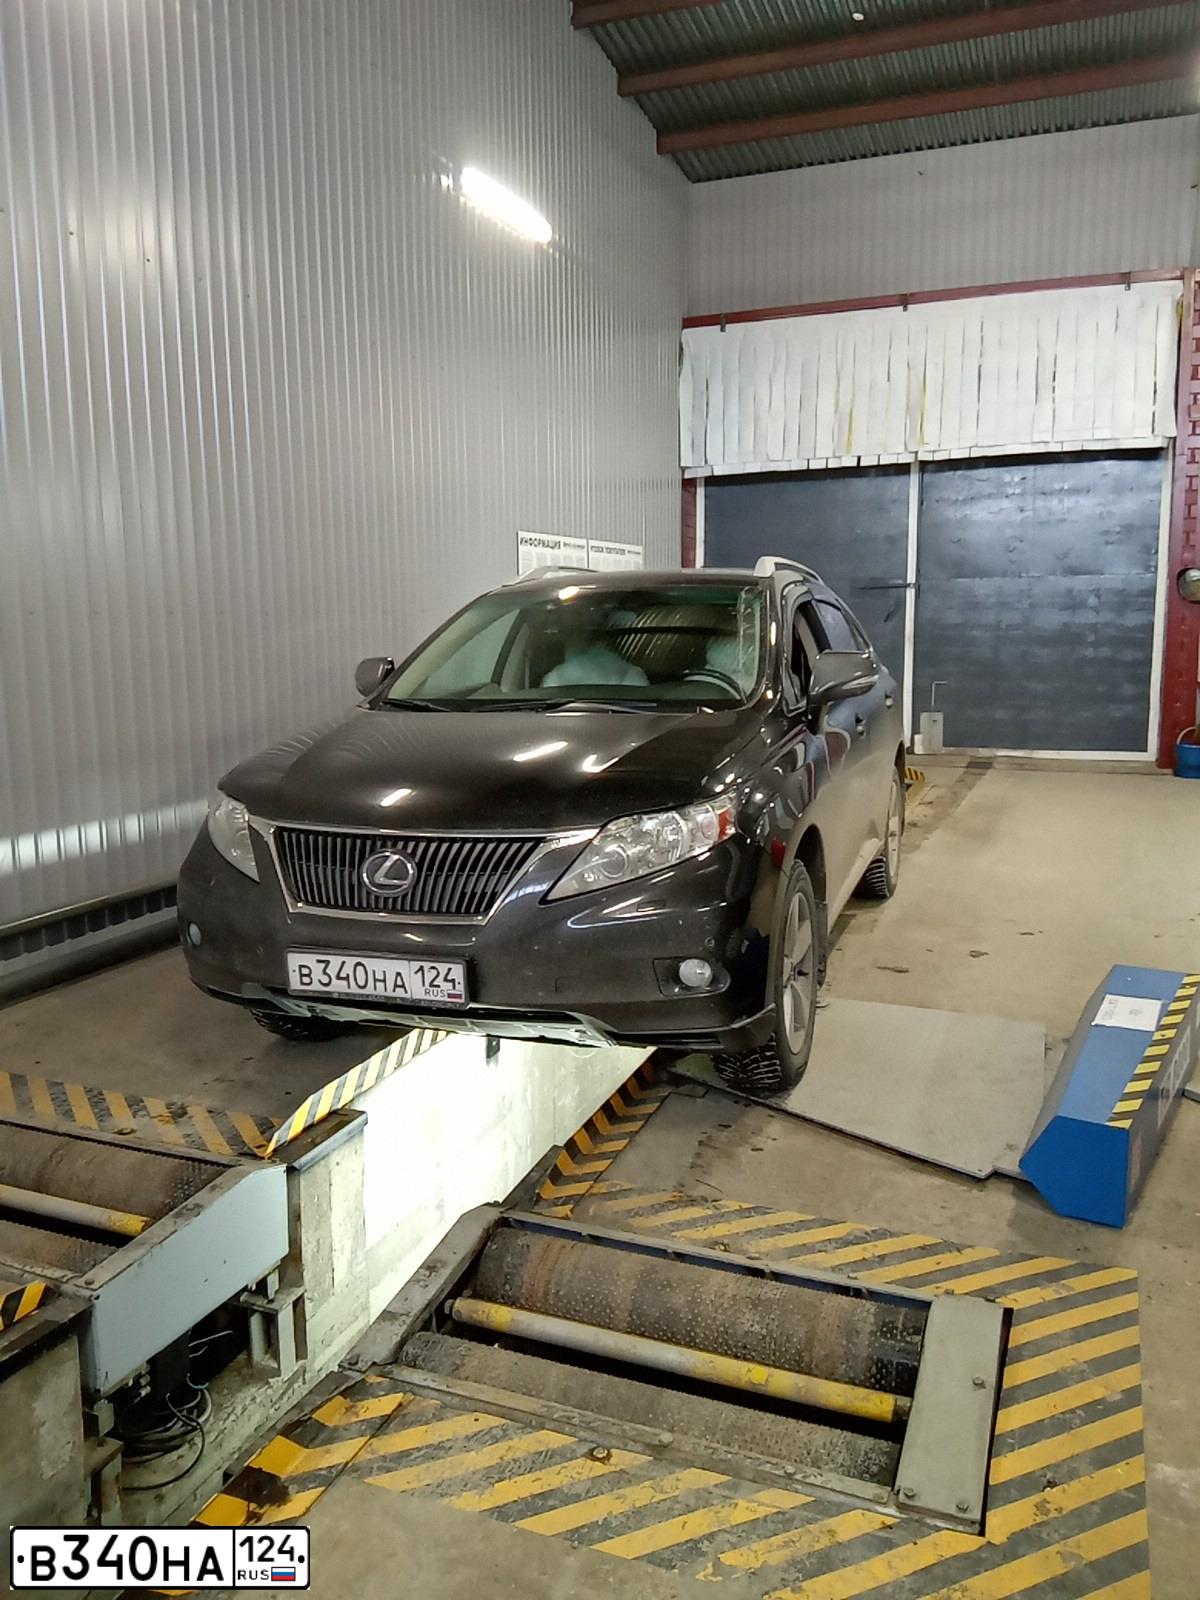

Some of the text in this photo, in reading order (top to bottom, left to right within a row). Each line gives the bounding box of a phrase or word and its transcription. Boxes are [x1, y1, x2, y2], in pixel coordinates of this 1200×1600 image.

[298, 959, 456, 994] В340НА 124
[424, 988, 446, 998] RUS
